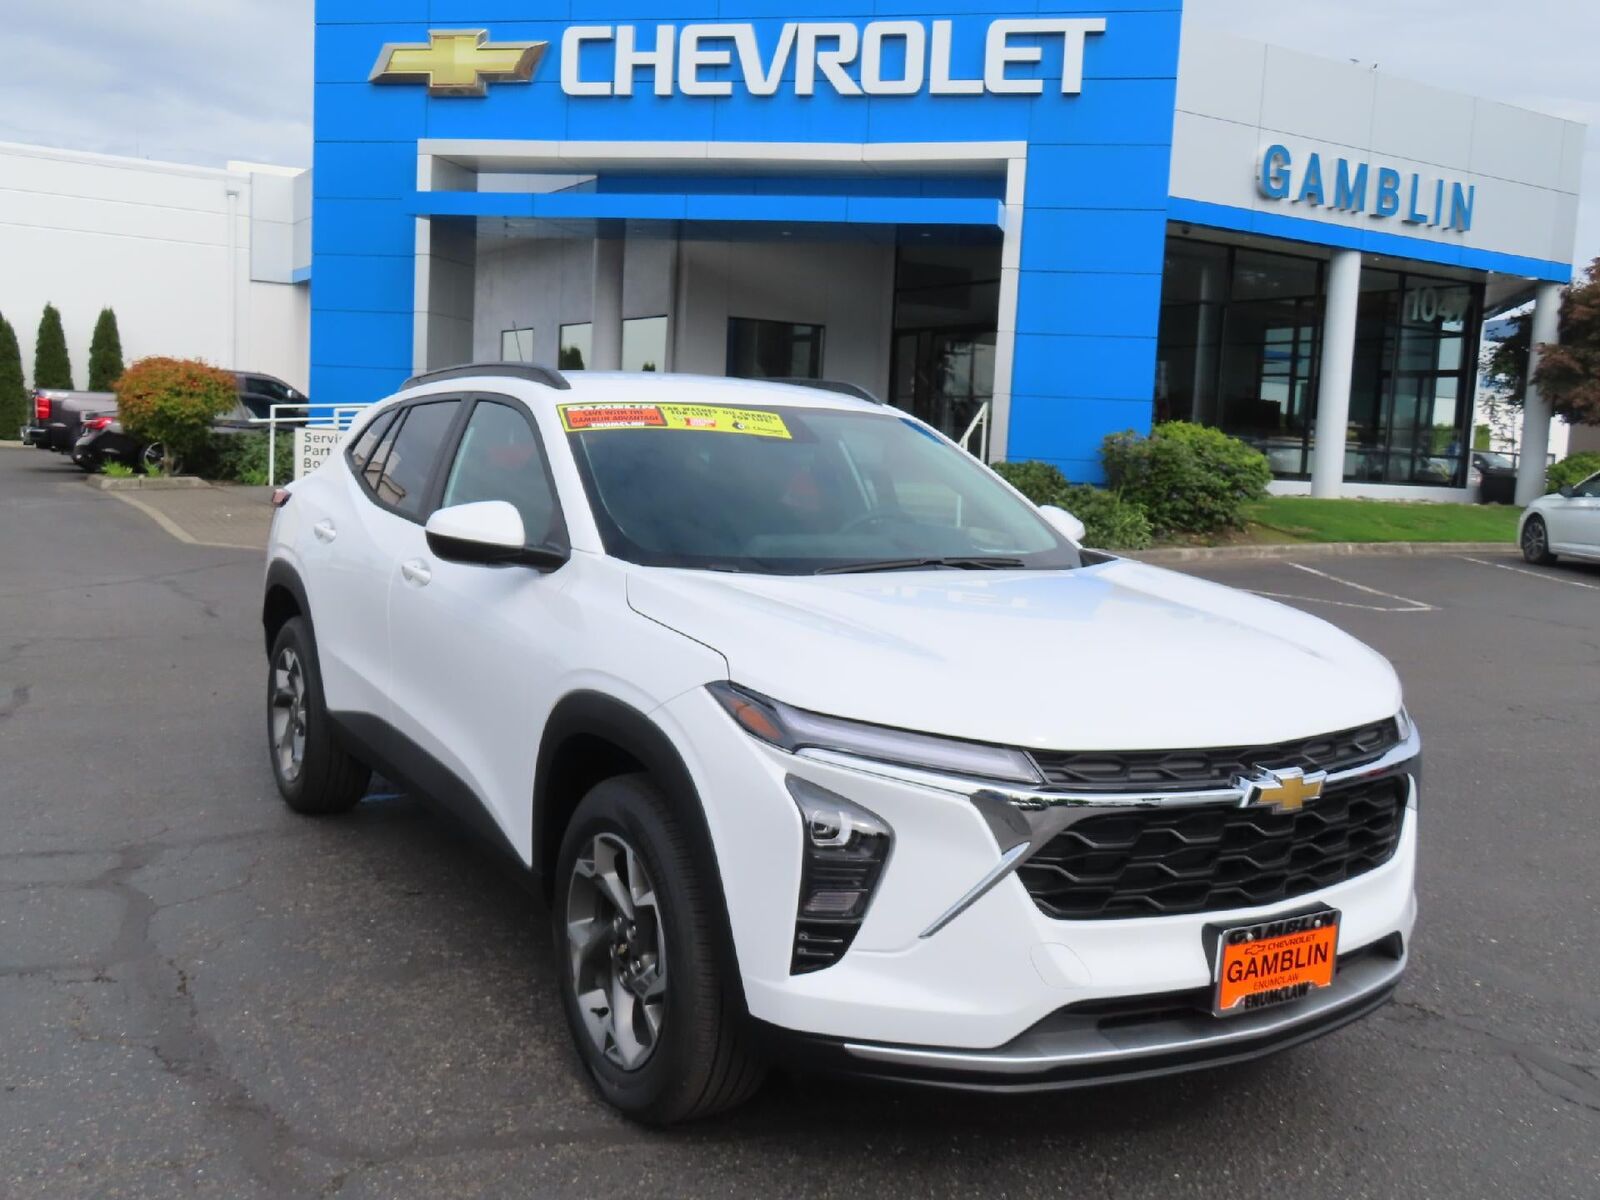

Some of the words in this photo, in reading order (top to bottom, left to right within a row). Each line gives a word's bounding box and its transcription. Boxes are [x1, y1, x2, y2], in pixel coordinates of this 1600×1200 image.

[561, 17, 1107, 97] CHEVROLET
[1257, 143, 1477, 233] GAMBLIN
[304, 432, 342, 444] Servi
[304, 445, 331, 456] Part
[303, 457, 321, 469] Bo
[1267, 933, 1317, 952] CHEVROLET
[1226, 941, 1329, 983] GAMBLIN
[1253, 973, 1299, 991] ENUMCLAW
[1244, 981, 1310, 1010] ENUMCLAW
